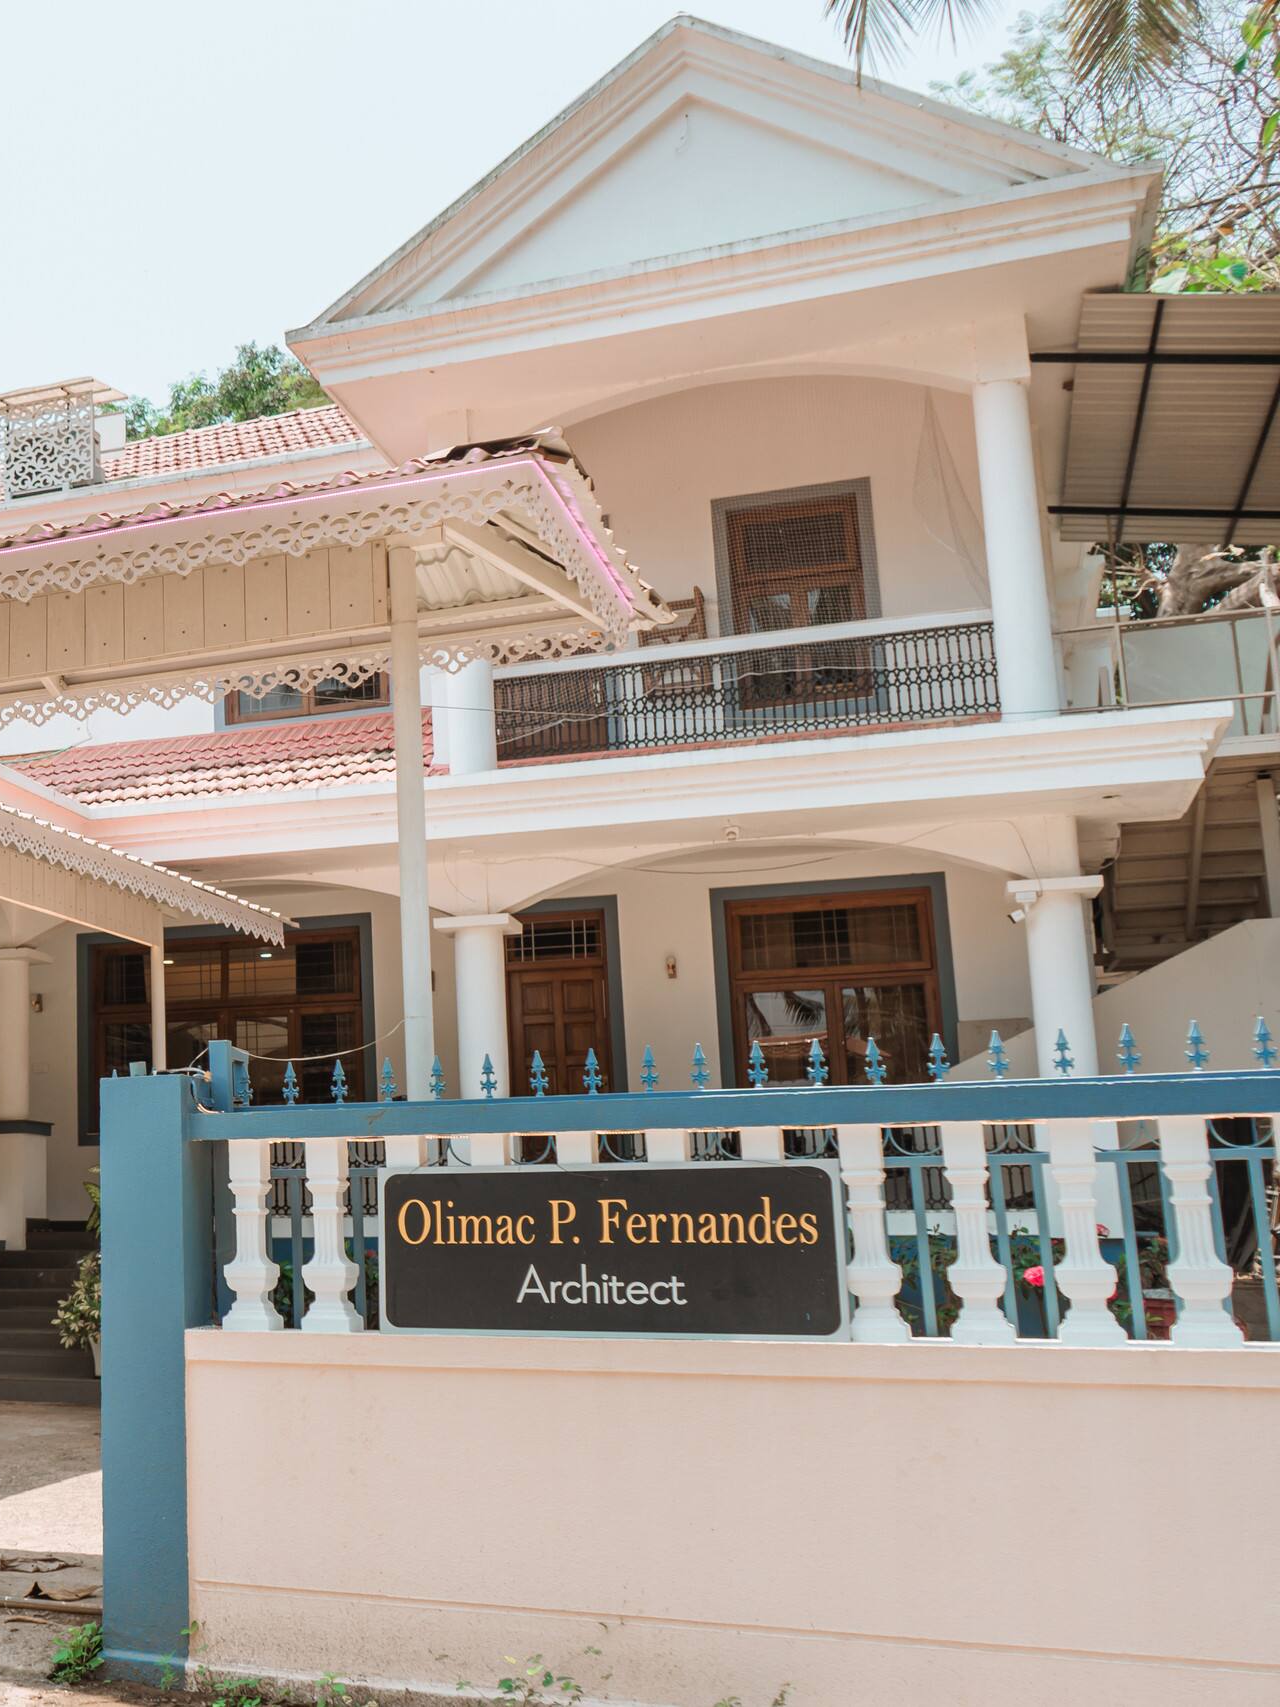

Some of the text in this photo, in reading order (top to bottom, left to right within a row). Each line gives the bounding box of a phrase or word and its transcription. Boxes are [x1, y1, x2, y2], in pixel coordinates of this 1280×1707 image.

[397, 1196, 819, 1246] Olimac P. Fernandes
[516, 1263, 688, 1306] Architect
